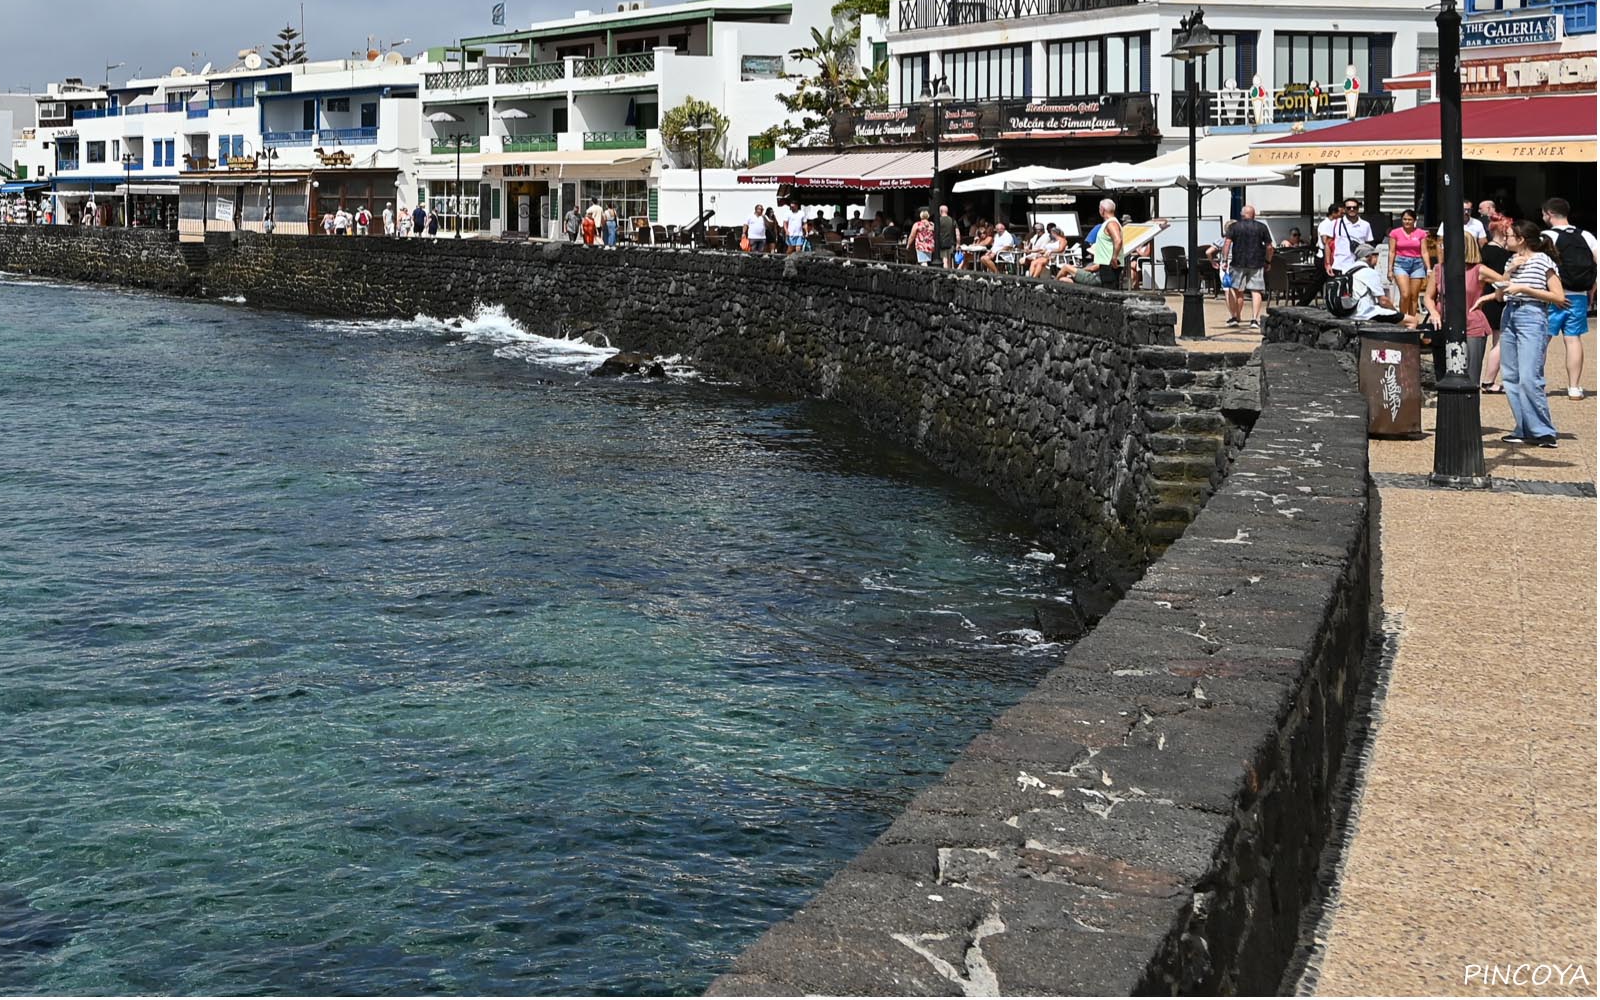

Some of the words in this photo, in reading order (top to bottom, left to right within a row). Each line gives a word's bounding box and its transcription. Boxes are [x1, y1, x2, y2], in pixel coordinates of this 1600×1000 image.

[1466, 24, 1483, 33] THE
[1484, 20, 1543, 38] GALERIA
[1495, 34, 1543, 44] COCKTAILS
[875, 124, 882, 135] de
[1010, 117, 1044, 129] Volcán
[1047, 117, 1059, 129] de
[1061, 116, 1116, 130] Timanfaya
[1270, 152, 1300, 160] TAPAS
[1320, 149, 1341, 159] BBQ
[1361, 147, 1415, 157] COCKTAIL
[1512, 147, 1538, 156] TEX
[1538, 146, 1566, 156] MEX
